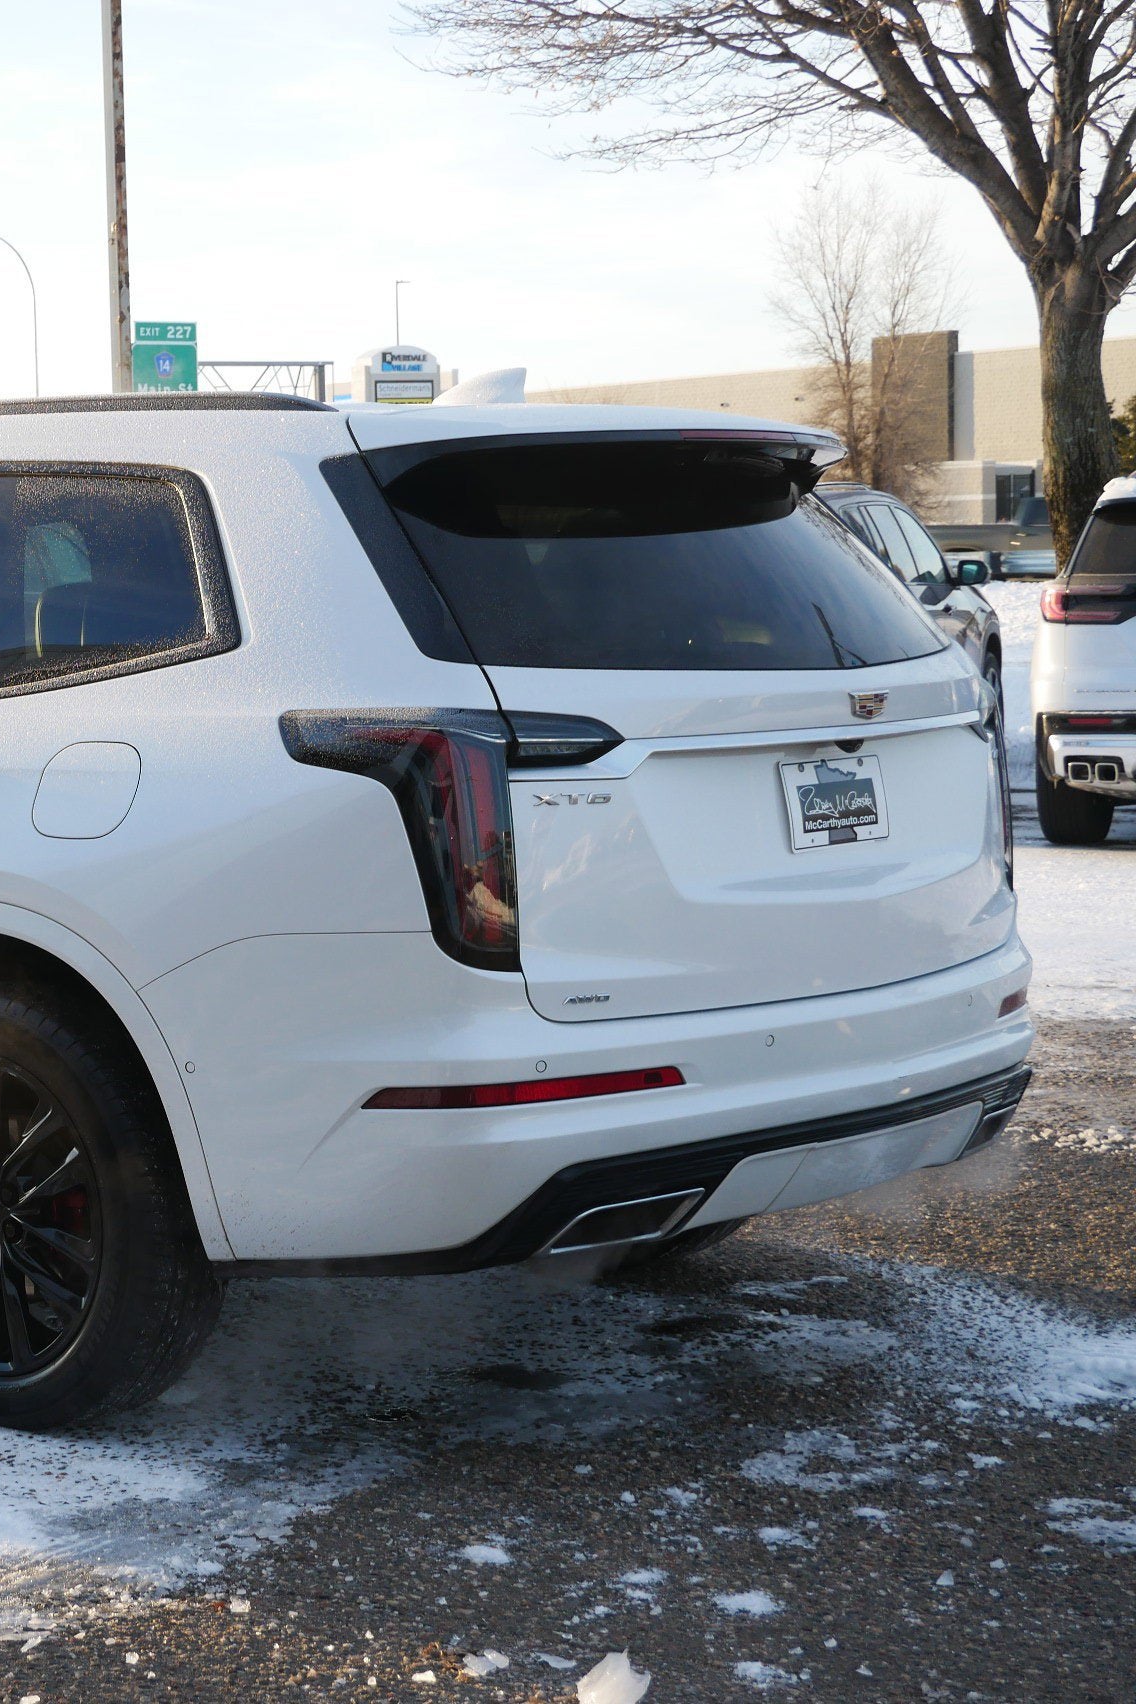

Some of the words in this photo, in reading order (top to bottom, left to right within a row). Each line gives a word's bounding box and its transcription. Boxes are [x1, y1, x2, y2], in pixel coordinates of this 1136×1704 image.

[139, 327, 160, 337] EXIT
[166, 326, 192, 339] 227
[159, 359, 170, 373] 14
[532, 792, 613, 807] XT6
[805, 814, 876, 831] McCarthyauto.com
